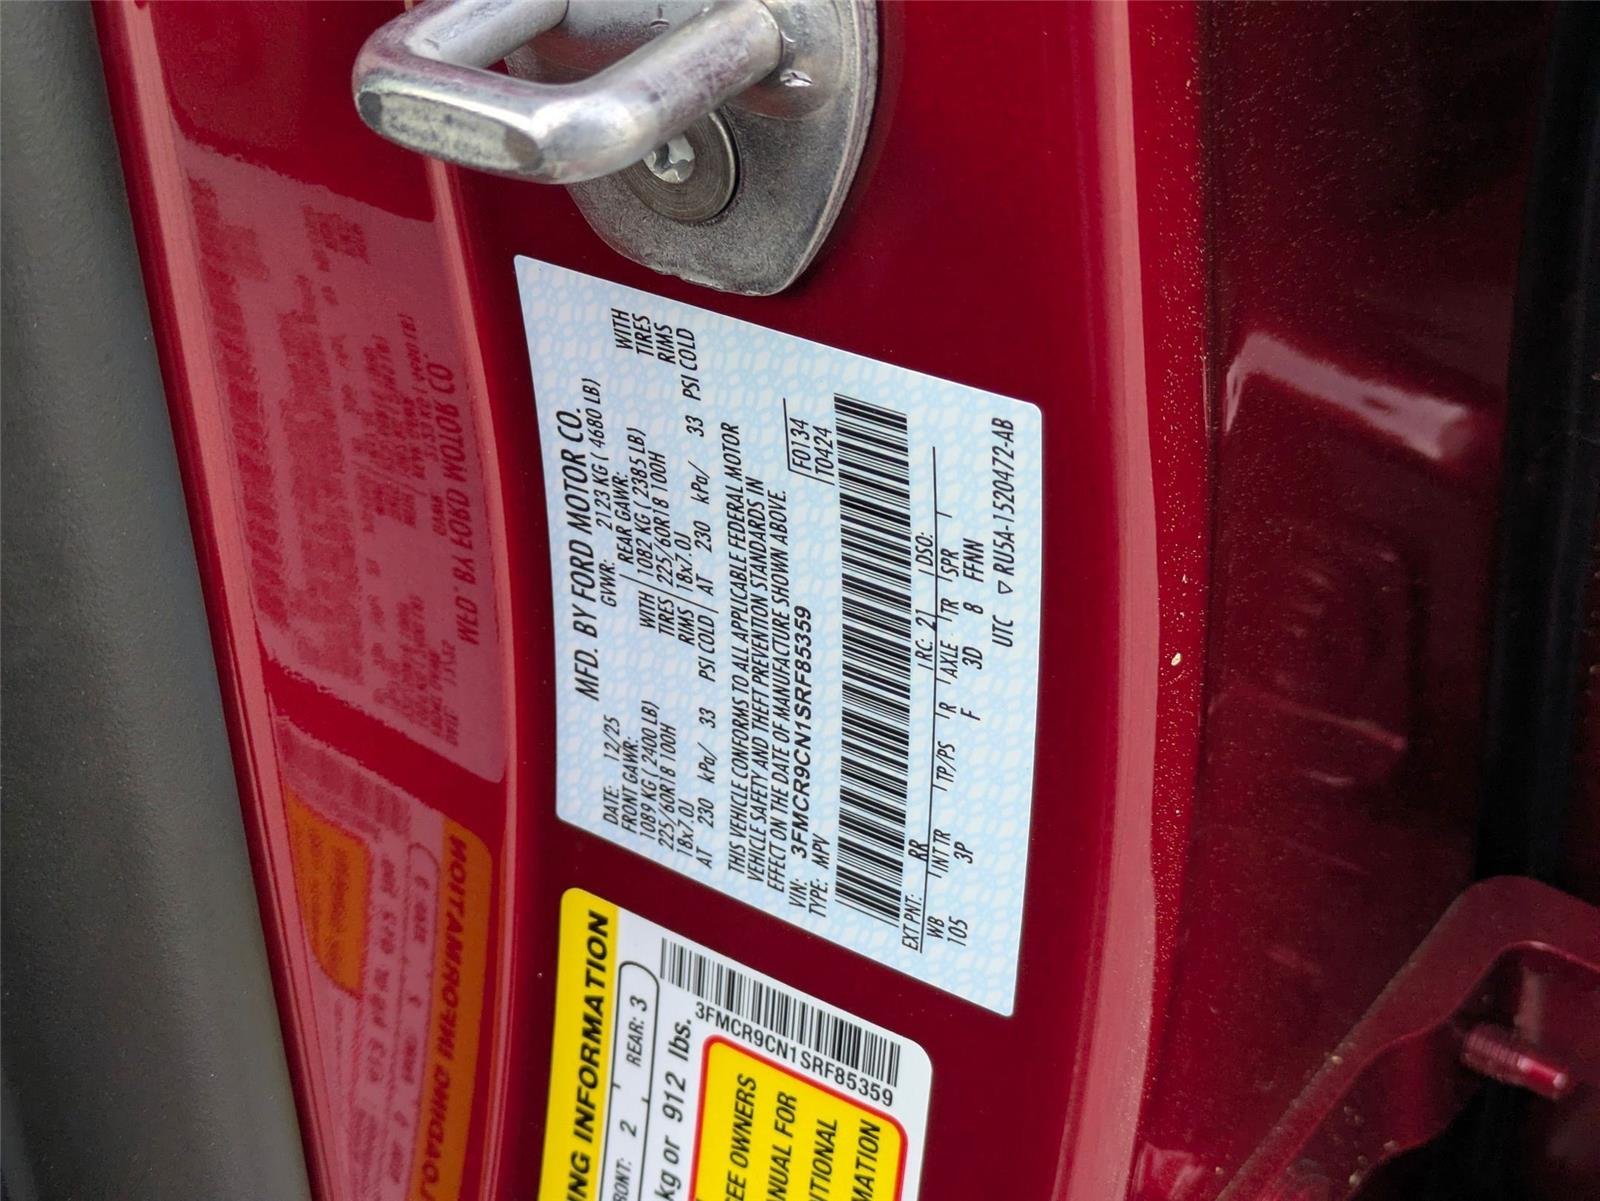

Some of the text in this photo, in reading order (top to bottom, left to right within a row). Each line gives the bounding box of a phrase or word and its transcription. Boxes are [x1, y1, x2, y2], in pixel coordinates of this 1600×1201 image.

[611, 307, 634, 350] WITH
[633, 313, 654, 357] TIRES
[654, 322, 676, 364] RIMS
[582, 376, 602, 406] LB)
[626, 426, 646, 455] LB)
[676, 326, 714, 596] AT 230 kPa/ 33 PSI COLD
[592, 462, 609, 487] KG
[593, 488, 613, 531] 2123
[612, 470, 634, 564] REAR GAWR:
[634, 511, 651, 536] KG
[648, 449, 674, 587] 225/60R18 100H
[556, 406, 600, 701] MFD. BY FORD MOTOR CO.
[636, 538, 655, 578] 1082
[674, 530, 694, 592] 18x7.0J
[915, 531, 934, 566] DSO:
[940, 547, 959, 578] SPR
[962, 537, 984, 583] FFNN
[598, 558, 617, 608] GVWR:
[638, 589, 656, 629] WITH
[658, 595, 674, 637] TIRES
[678, 608, 695, 646] RIMS
[940, 597, 959, 616] TR
[962, 600, 984, 615] 8
[720, 421, 749, 874] THIS VEHICLE CONFORMS TO ALL APPLICABLE FEDERAL MOTOR
[915, 608, 936, 662] RC: 21
[992, 613, 1014, 648] UTC
[745, 474, 770, 882] VEHICLE SAFETY AND THEFT PREVENTION STANDARDS IN
[940, 639, 959, 679] AXLE
[962, 645, 982, 670] 3D
[767, 488, 790, 893] EFFECT ON THE DATE OF MANUFACTURE SHOWN ABOVE.
[938, 701, 956, 714] R
[641, 699, 660, 726] LB)
[960, 706, 980, 721] F
[696, 614, 717, 869] AT 230 kPa/ 33 PSI COLD
[788, 604, 812, 908] VIN: 3FMCR9CN1SRF85359
[936, 740, 956, 783] TP/PS
[603, 714, 620, 826] DATE: 12/25
[622, 735, 638, 834] FRONT GAWR:
[641, 778, 657, 800] KG
[658, 721, 676, 850] 225/60R18 100H
[640, 802, 656, 840] 1089
[677, 798, 694, 857] 18x7.0J
[932, 828, 950, 873] INT TR
[954, 840, 974, 864] 3P
[809, 832, 830, 918] TYPE: MPV
[902, 838, 929, 951] EXT PNT: RR
[926, 914, 944, 940] WB
[947, 914, 968, 946] 105
[572, 908, 609, 1143] INFORMATION
[626, 994, 648, 1067] REAR: 3
[695, 1000, 893, 1106] 3FMCR9CN1SRF85359
[620, 1118, 637, 1137] 2
[654, 1018, 692, 1200] kg or 912 lbs.
[729, 1072, 757, 1168] OWNERS
[774, 1090, 797, 1138] FOR
